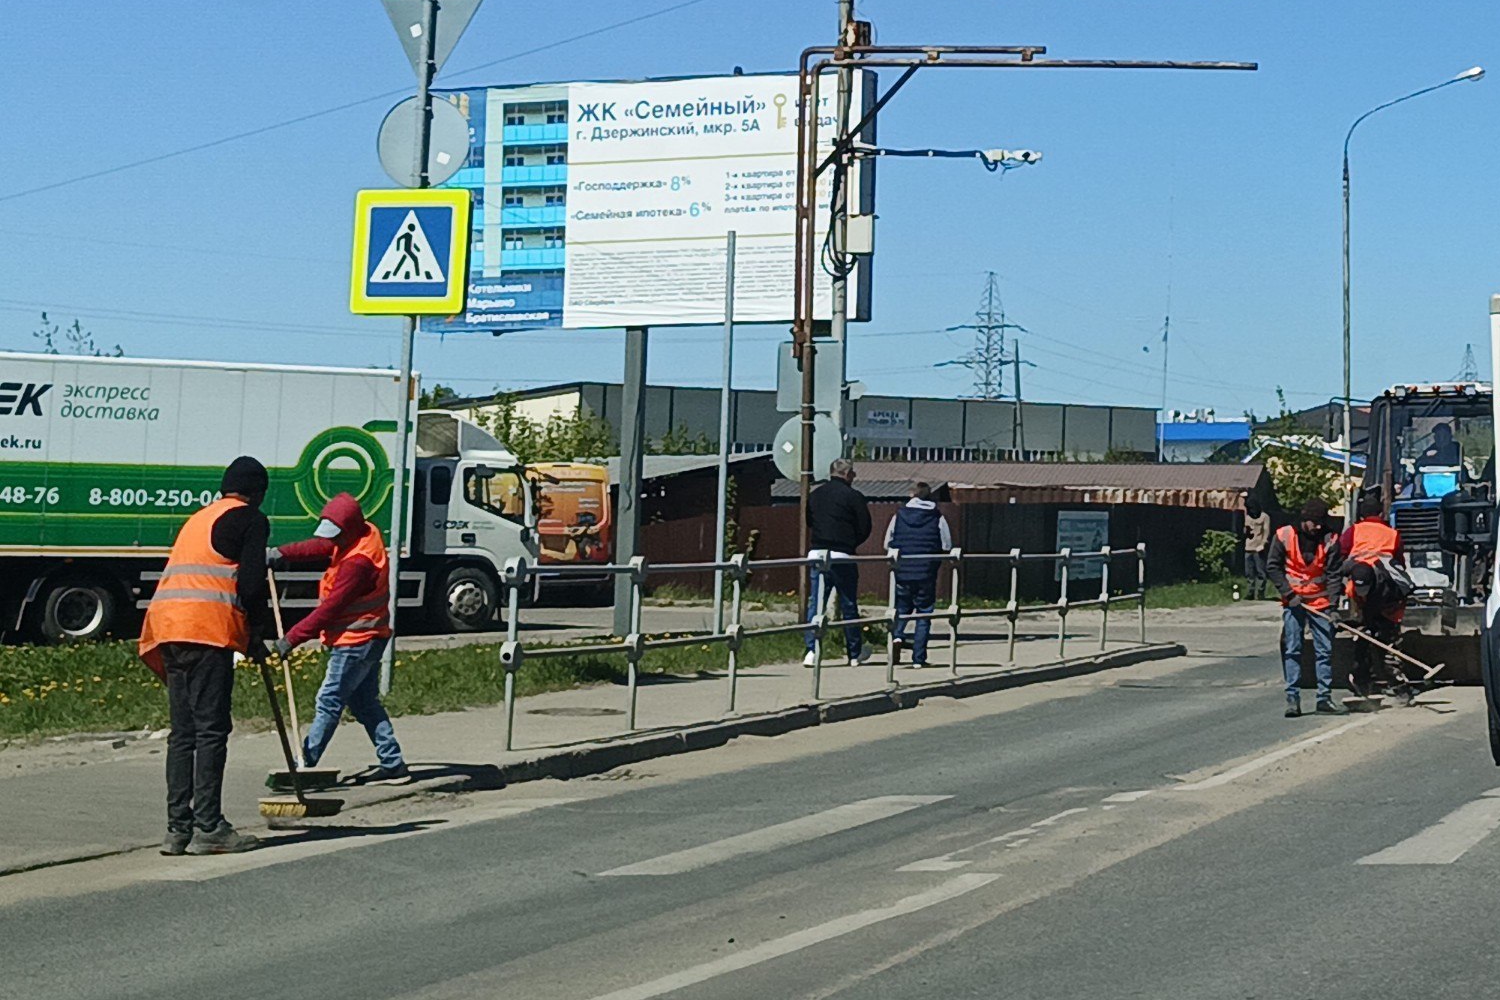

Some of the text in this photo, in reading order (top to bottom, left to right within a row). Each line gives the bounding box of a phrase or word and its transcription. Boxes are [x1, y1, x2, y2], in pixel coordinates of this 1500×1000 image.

[577, 94, 766, 122] ЖК «Семейный»
[576, 119, 760, 142] г. Дзержинский, мкр. 5А
[63, 384, 150, 403] экспресс
[61, 400, 160, 421] доставка
[0, 435, 42, 449] ek.ru
